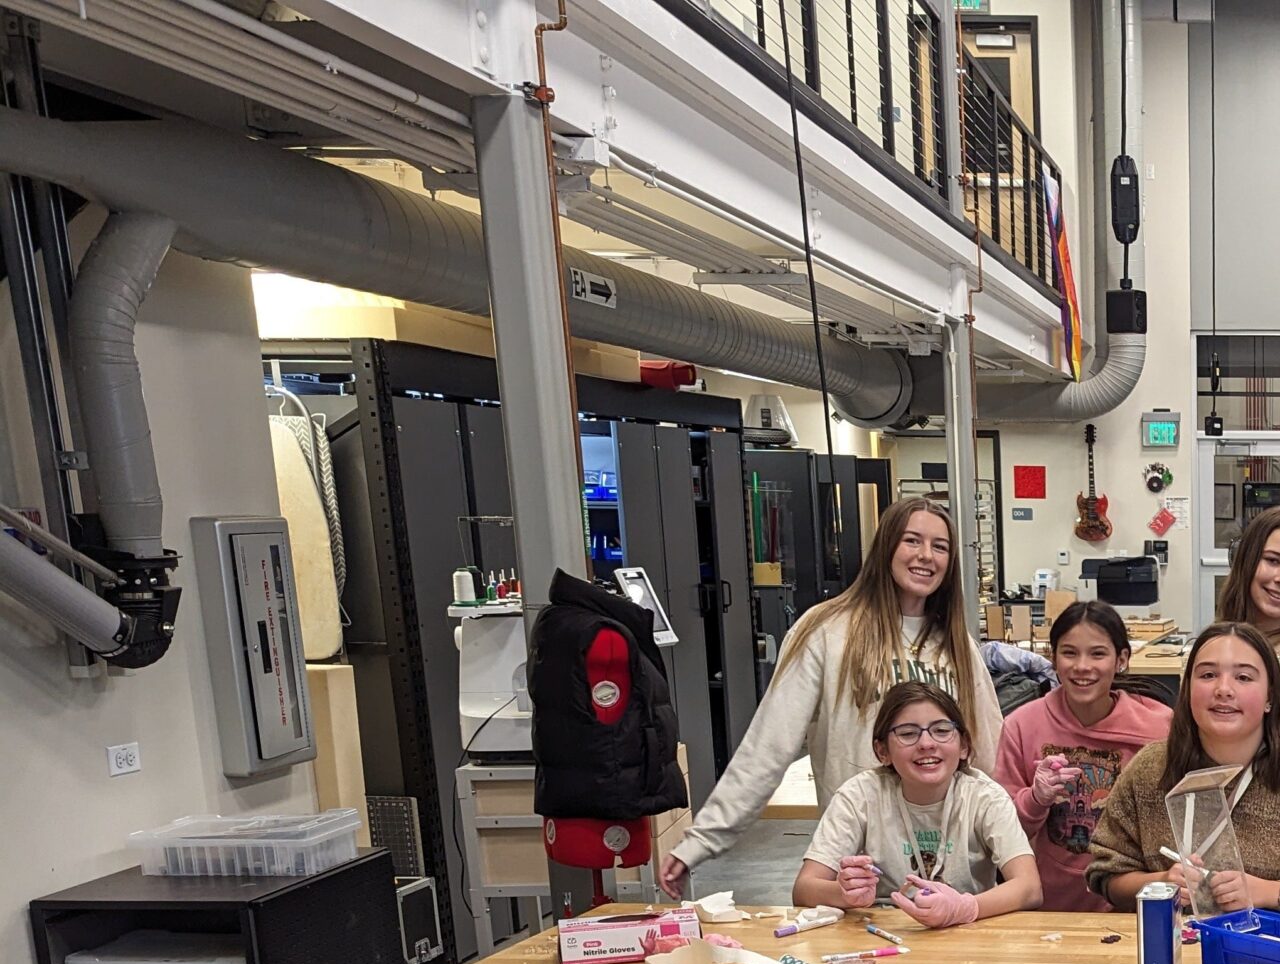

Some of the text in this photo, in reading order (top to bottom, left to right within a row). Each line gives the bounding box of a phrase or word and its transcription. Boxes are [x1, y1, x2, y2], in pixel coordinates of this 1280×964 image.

[572, 269, 587, 299] EA
[261, 560, 287, 726] FIRE EXTINGUISHER
[583, 946, 636, 957] Nitrile Gloves
